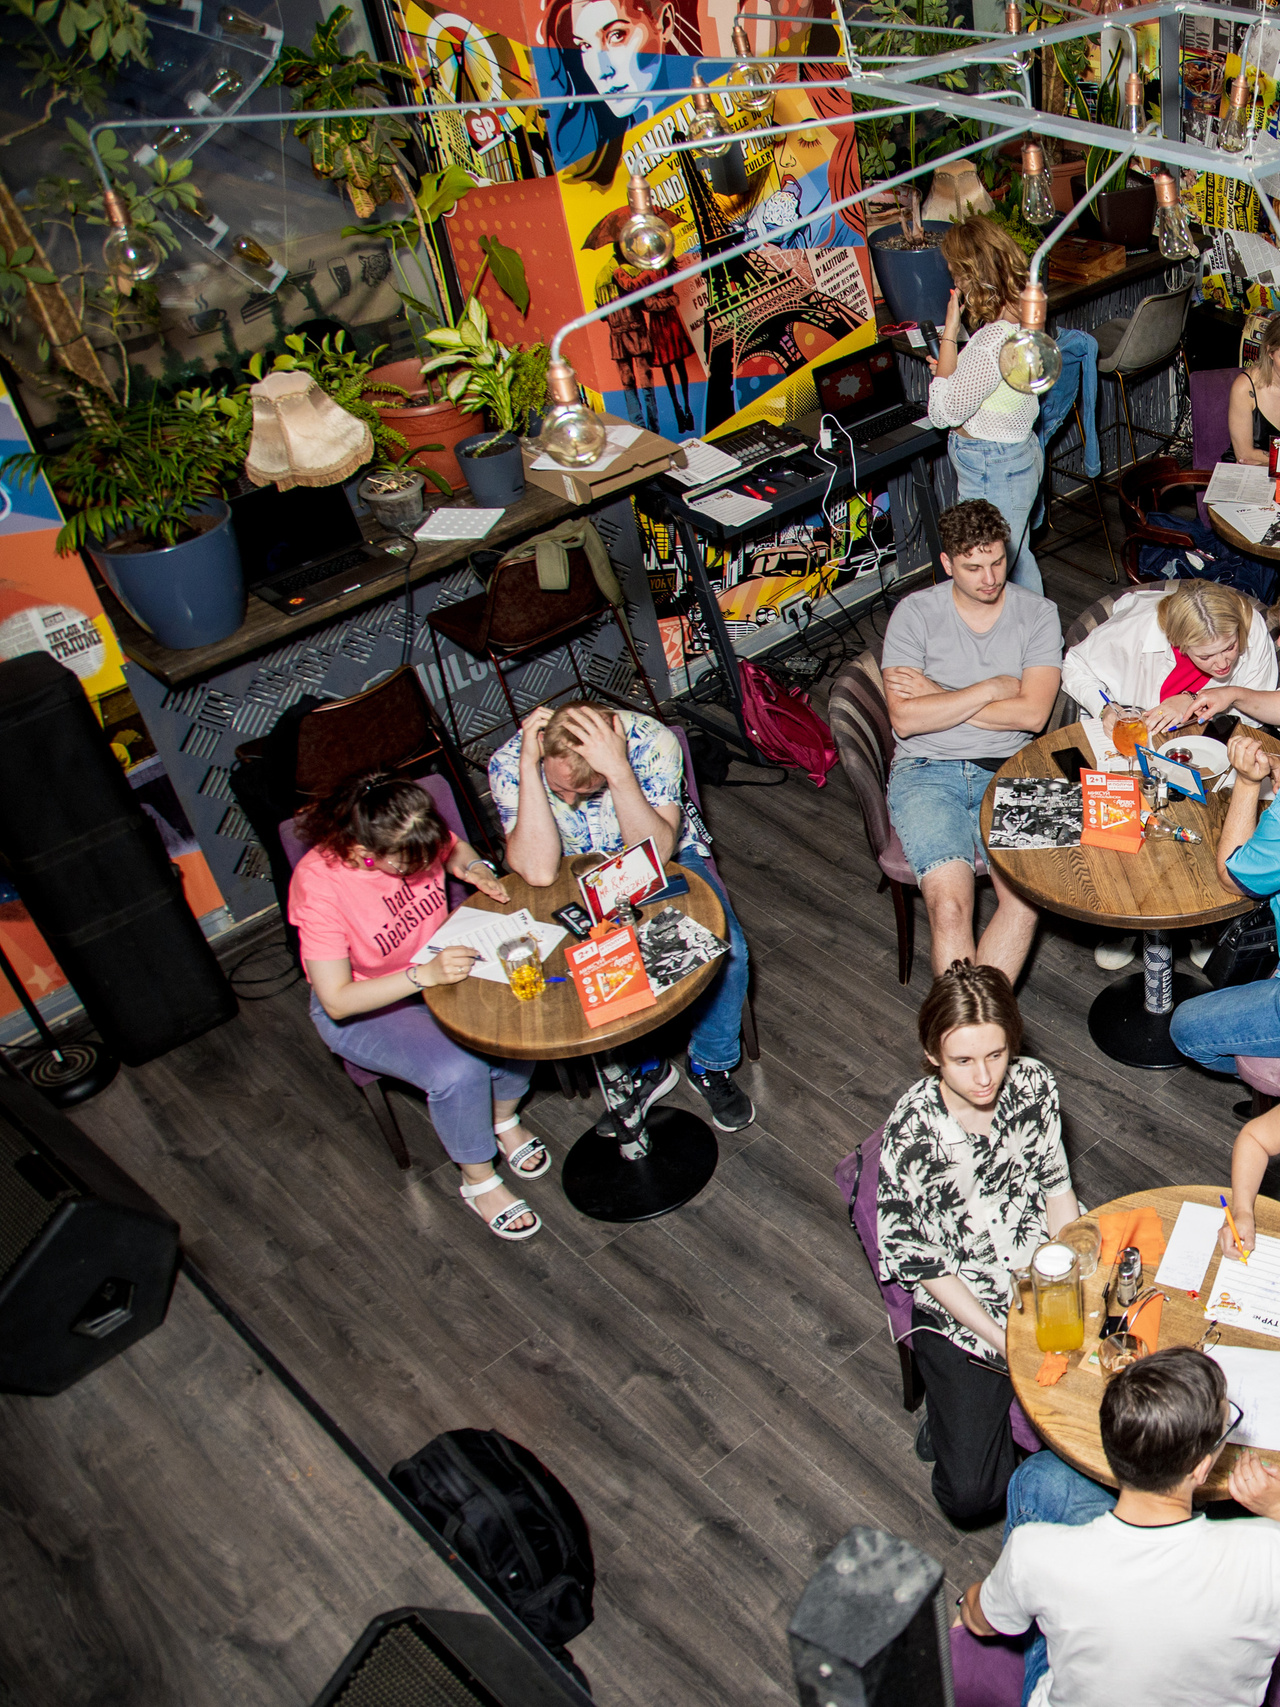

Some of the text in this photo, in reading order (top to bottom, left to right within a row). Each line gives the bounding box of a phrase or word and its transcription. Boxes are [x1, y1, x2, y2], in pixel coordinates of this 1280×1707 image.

[471, 117, 496, 141] SP
[45, 623, 81, 645] TAYLOR
[382, 877, 415, 918] bad
[373, 878, 448, 957] Decisions
